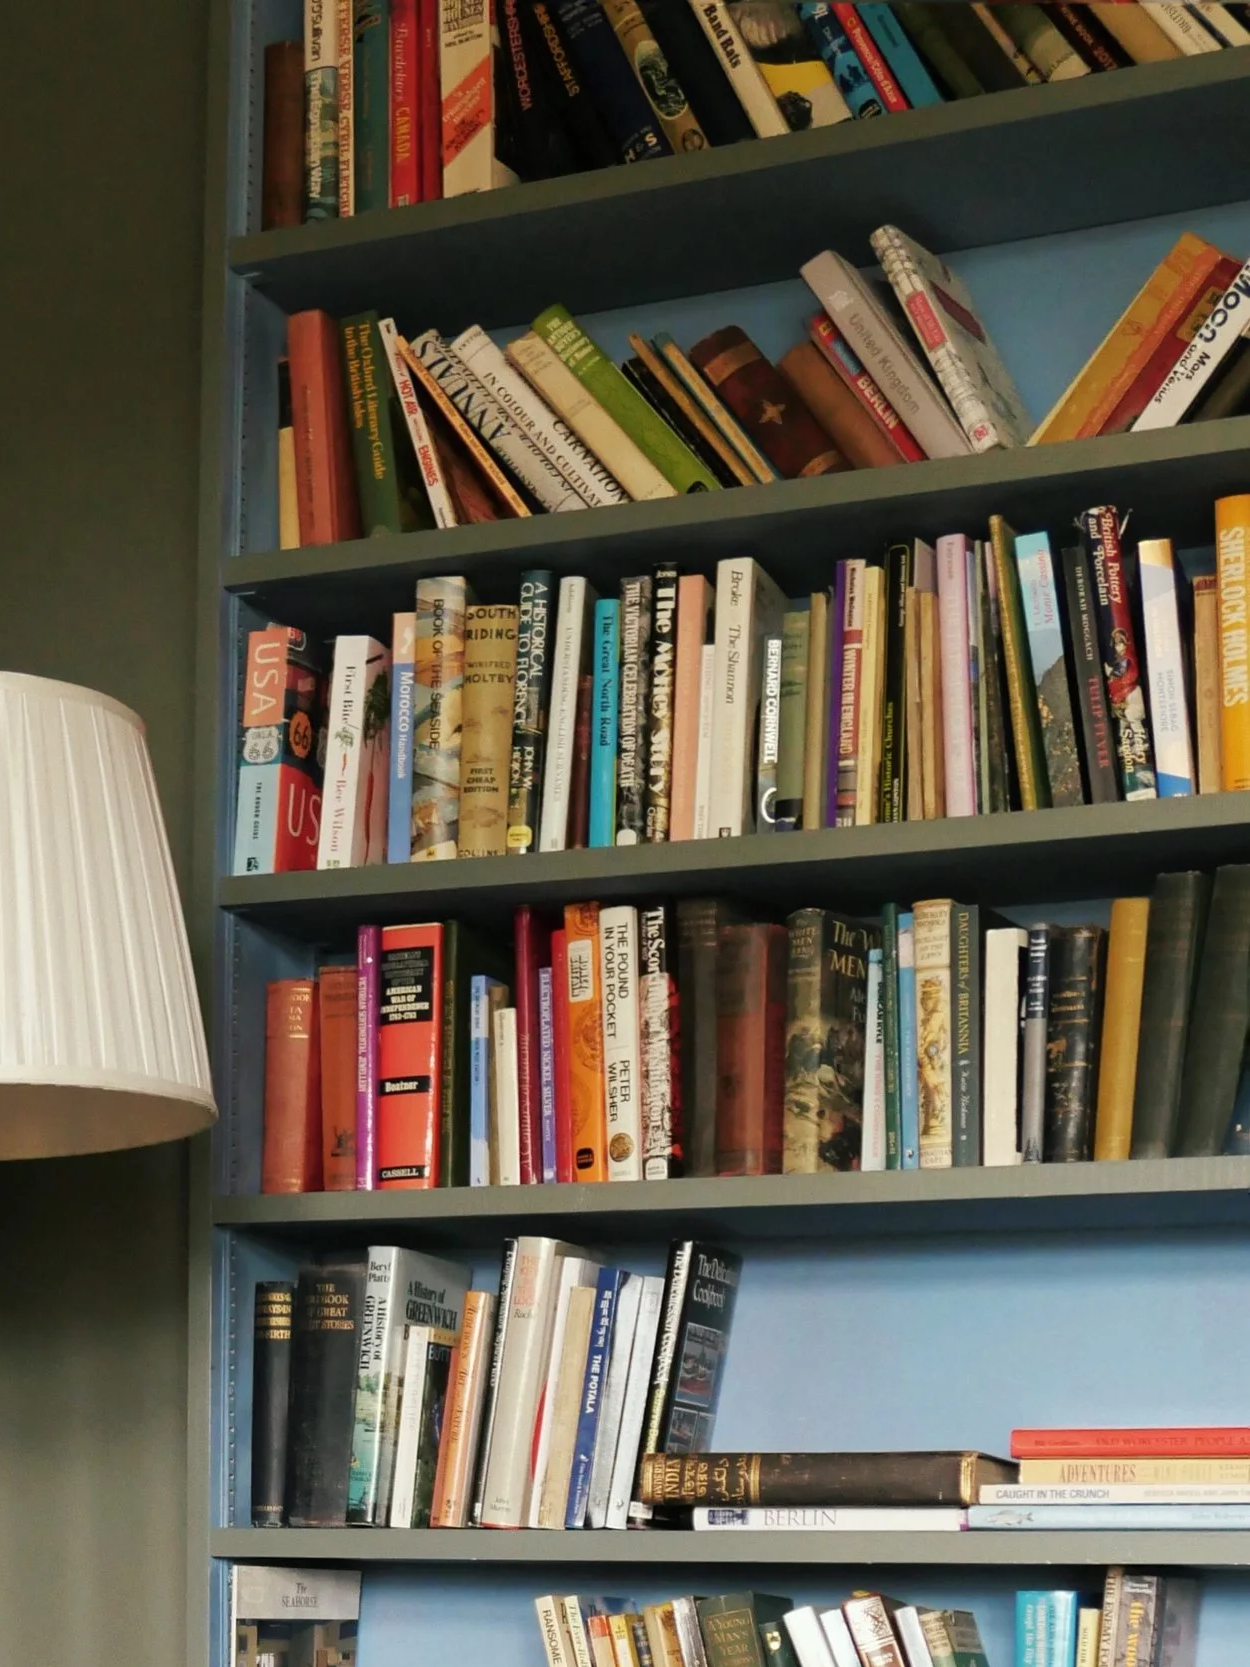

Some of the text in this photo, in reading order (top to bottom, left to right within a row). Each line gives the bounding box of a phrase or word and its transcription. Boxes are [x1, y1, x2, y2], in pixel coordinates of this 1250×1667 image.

[702, 4, 743, 69] Band Rats
[395, 107, 410, 162] CANADA
[847, 312, 921, 416] United Kingdom
[1177, 342, 1202, 370] and
[1182, 350, 1211, 382] Mars
[358, 321, 386, 480] The Oxford Literary Guide
[398, 379, 419, 417] HOT AIR
[410, 335, 512, 448] ANNUALS
[482, 370, 558, 456] IN COLOUR AND
[856, 373, 901, 430] BERLIN
[1152, 367, 1183, 406] Venus
[418, 444, 439, 486] ENGINES
[1087, 517, 1110, 605] and Porcelain
[1100, 512, 1125, 604] British Pottery
[465, 628, 517, 641] RIDING
[467, 608, 517, 621] SOUTH
[525, 582, 550, 680] A HISTORICAL
[655, 582, 675, 634] The
[1072, 565, 1096, 661] DEBORAH MOGGACH
[1218, 526, 1250, 706] SHERLOCK HOLMES
[512, 581, 534, 725] GUIDE TO FLORENCE
[721, 569, 744, 704] Broke The Shannon
[249, 639, 281, 718] USA
[342, 666, 357, 694] First
[428, 599, 445, 750] BOOK THE SEASIDE
[465, 674, 514, 684] HOLTBY
[597, 612, 614, 747] The Great North Road
[618, 581, 641, 789] THE VICTORIAN CELEBRATION OF DEATH
[651, 640, 672, 719] Money
[758, 638, 783, 763] BERNARD CORNWELL
[838, 648, 857, 754] WINTER IN ENGLAND
[395, 670, 414, 778] Morocco Handbook
[880, 701, 896, 791] Historic Churches
[1085, 675, 1112, 768] TULIP FEVER
[1129, 726, 1151, 765] Henry
[647, 728, 668, 796] Story
[329, 806, 345, 852] Wilson
[646, 906, 663, 937] The
[833, 921, 856, 949] The
[603, 926, 616, 1037] IN YOUR POCKET
[616, 923, 629, 998] THE POUND
[829, 950, 866, 975] MEN
[957, 912, 969, 1054] DAUGHTERS BRITANNIA
[540, 974, 551, 1115] ELECTROPLATED NICKEL SILVER
[605, 1062, 620, 1121] WILSHER
[616, 1059, 633, 1102] PETER
[382, 1168, 419, 1178] CASSELL
[368, 1273, 390, 1283] Platts
[370, 1261, 391, 1273] Beryl
[673, 1250, 688, 1269] The
[406, 1300, 458, 1331] GREENWICH
[408, 1281, 438, 1303] A History
[663, 1268, 686, 1332] Delicatessen
[359, 1295, 376, 1369] GREENWICH
[372, 1296, 387, 1346] A History
[583, 1353, 601, 1413] THE POTALA
[653, 1330, 676, 1385] Cookbook
[665, 1458, 680, 1498] INDIA
[996, 1488, 1109, 1499] CAUGHT IN THE CRUNCH
[1059, 1462, 1136, 1484] ADVENTURES
[764, 1509, 837, 1526] BERLIN
[281, 1595, 319, 1608] SEAHORSE
[296, 1582, 307, 1595] The
[1105, 1575, 1116, 1595] THE
[540, 1608, 562, 1665] RANSOME
[568, 1603, 582, 1626] The
[1100, 1601, 1114, 1645] ENEMY
[1128, 1601, 1145, 1628] the
[720, 1644, 749, 1657] YEAR
